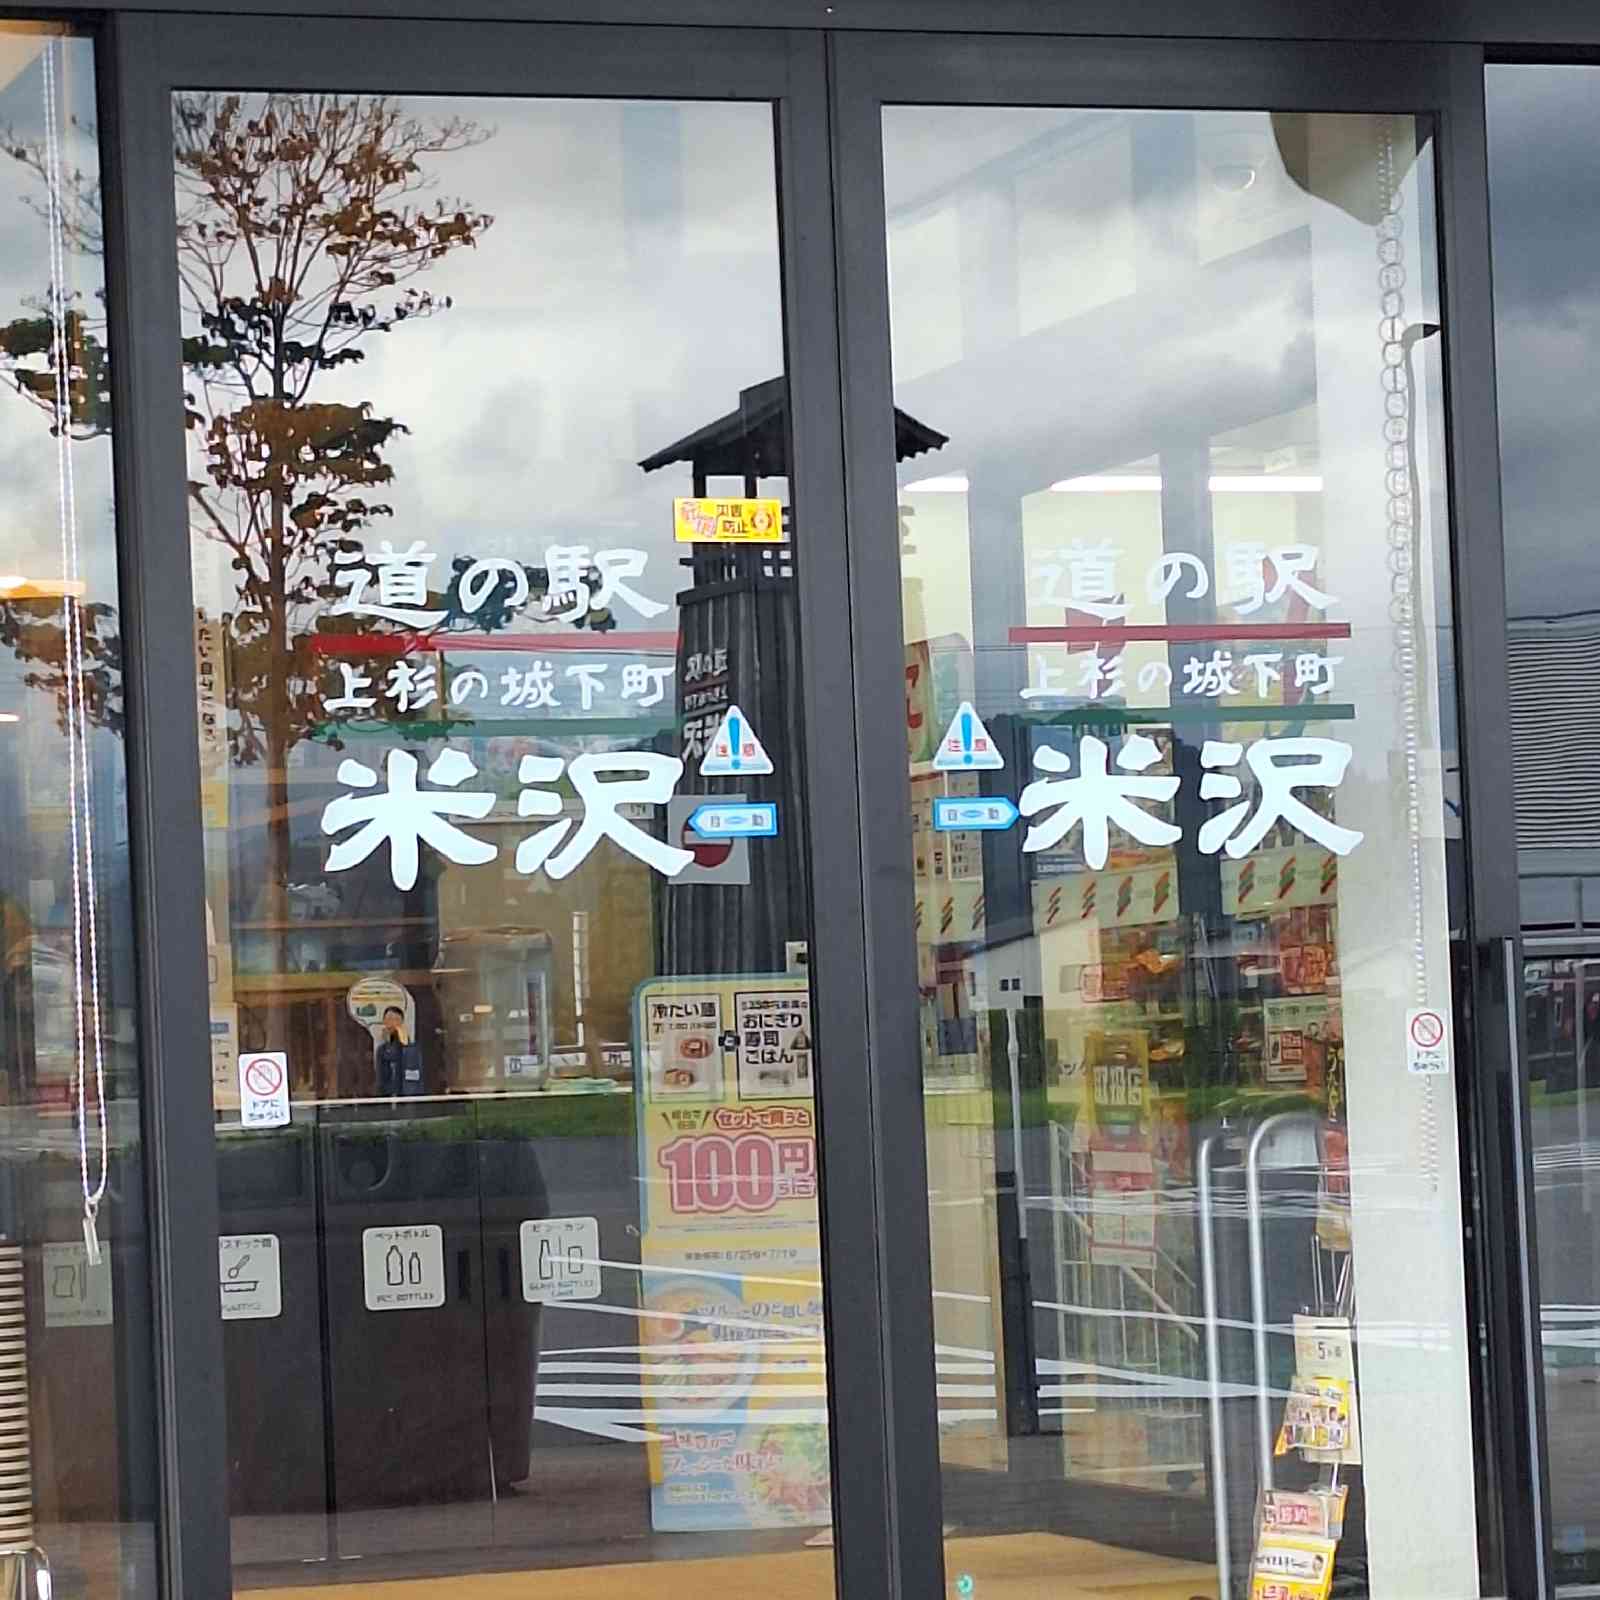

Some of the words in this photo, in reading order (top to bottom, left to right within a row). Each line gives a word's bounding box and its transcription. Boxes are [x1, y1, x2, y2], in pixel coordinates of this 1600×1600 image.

[330, 541, 670, 628] 道の駅
[1033, 539, 1340, 619] 道の駅
[322, 661, 675, 712] 上杉の城下町
[1018, 649, 1345, 699] 上杉の城下町
[321, 747, 695, 891] 米沢
[1018, 734, 1364, 871] 米沢
[743, 1014, 803, 1028] おにぎり
